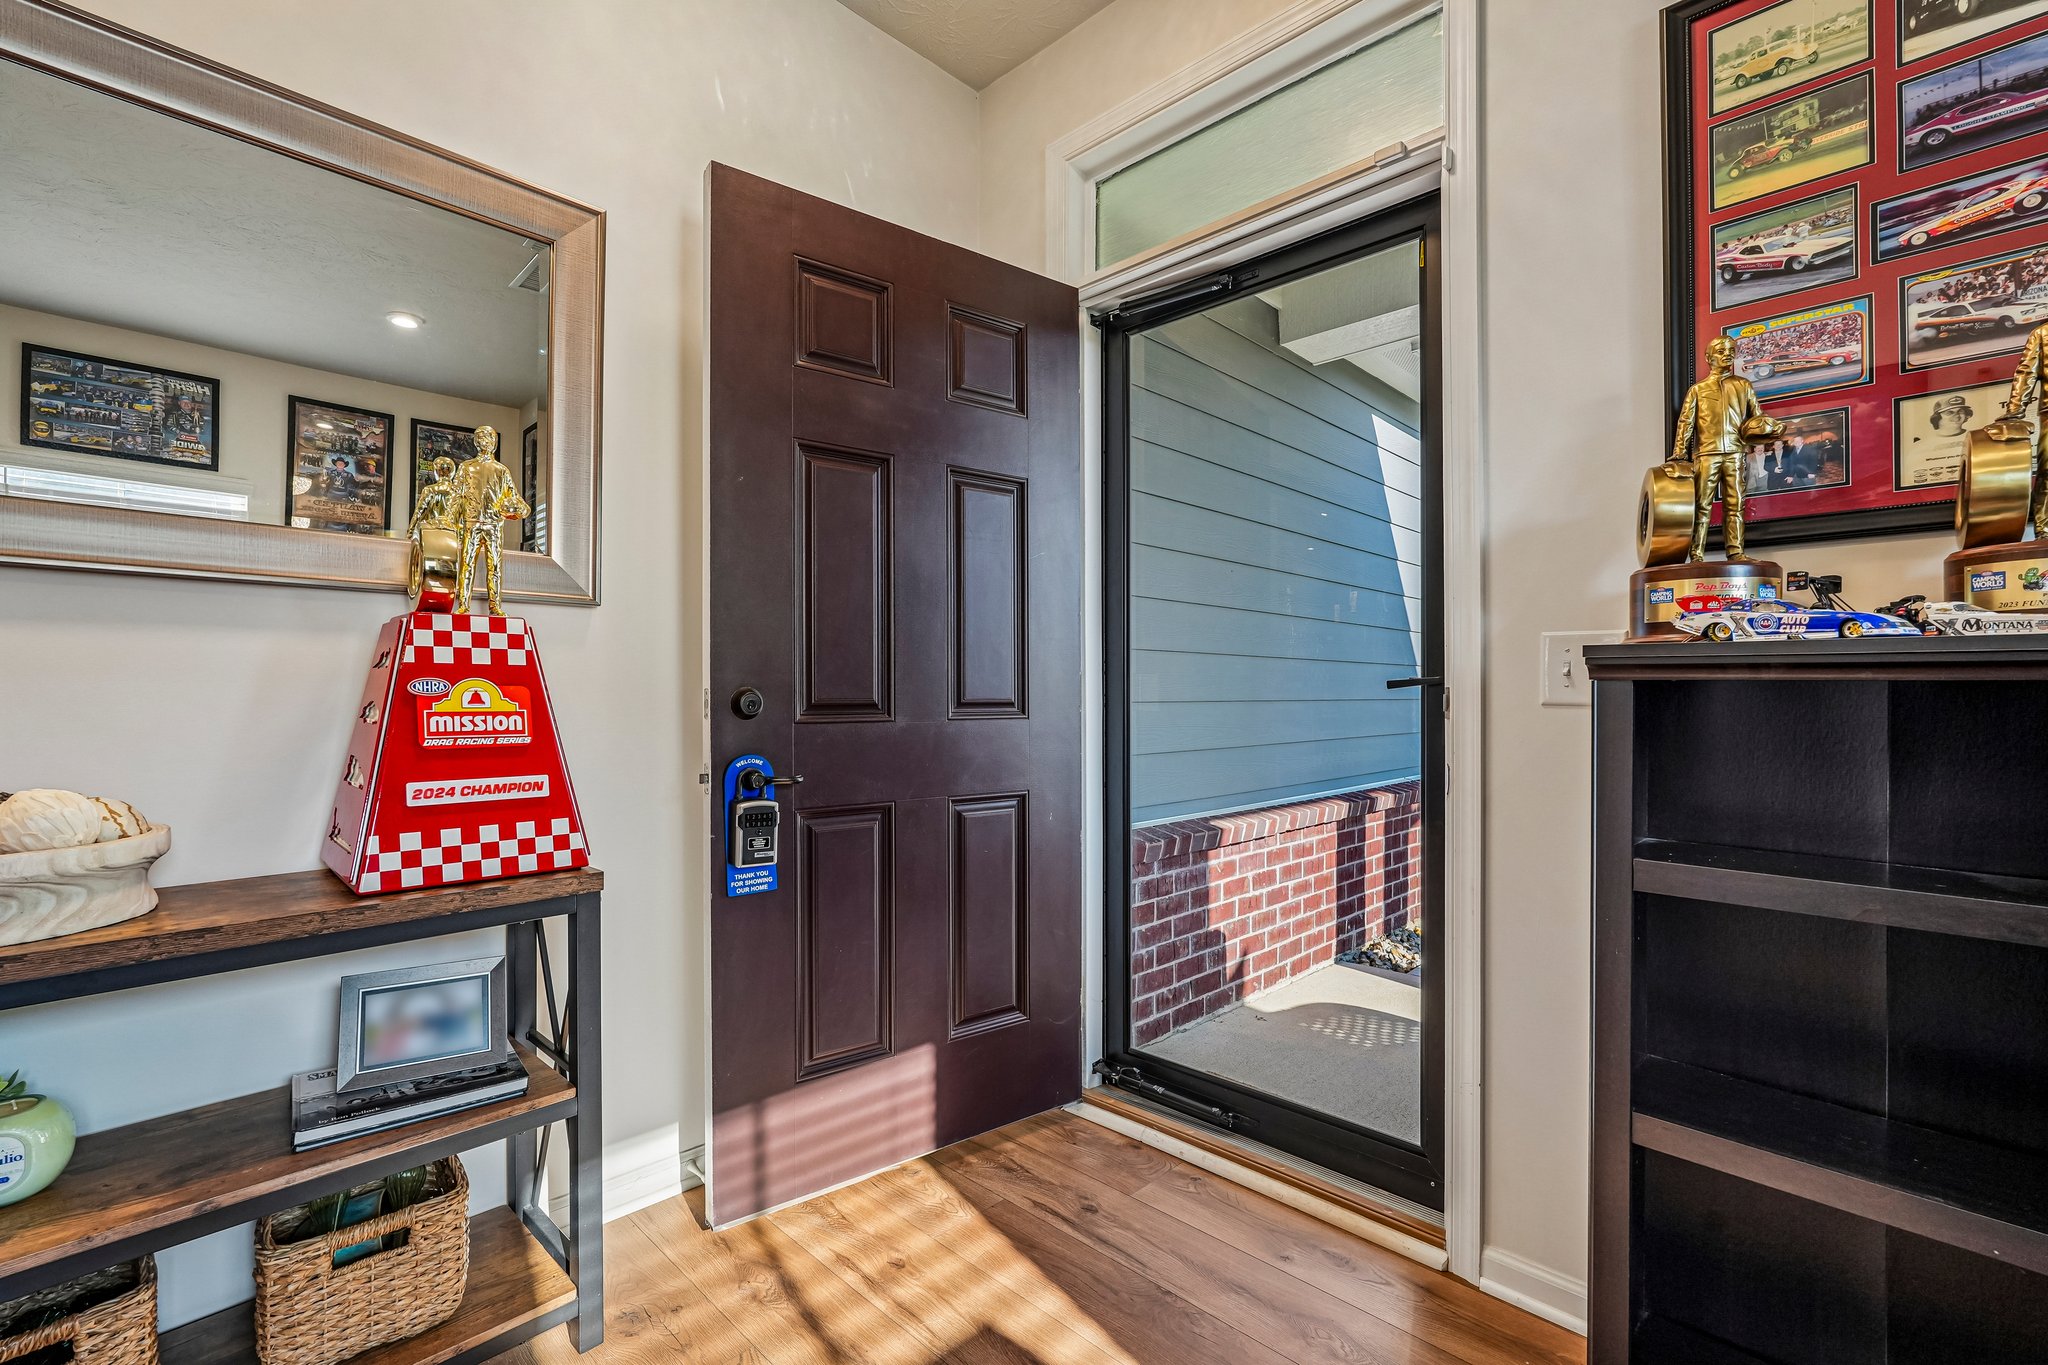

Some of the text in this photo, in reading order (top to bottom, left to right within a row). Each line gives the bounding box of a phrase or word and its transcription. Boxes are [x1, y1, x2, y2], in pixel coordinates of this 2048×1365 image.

[1953, 201, 2006, 224] Custom Body
[1768, 303, 1855, 328] SUPERSTAR
[1972, 574, 2004, 583] CAMPING
[1720, 581, 1749, 592] Boys
[1972, 580, 2004, 589] WORLD
[1650, 590, 1673, 598] CAMPING
[1998, 600, 2019, 609] 2023
[1780, 615, 1810, 624] AUTO
[1779, 624, 1807, 633] CLUB
[1962, 617, 2034, 633] MONTANA
[411, 680, 447, 693] NHRA
[422, 736, 532, 747] DRAG RACING SERIES
[735, 758, 764, 768] WELCOME
[411, 781, 545, 801] 2024 CHAMPION
[734, 870, 769, 880] THANK YOU
[730, 877, 773, 888] FOR SHOWING
[736, 884, 769, 894] OUR HOME
[350, 1107, 381, 1117] Pollock
